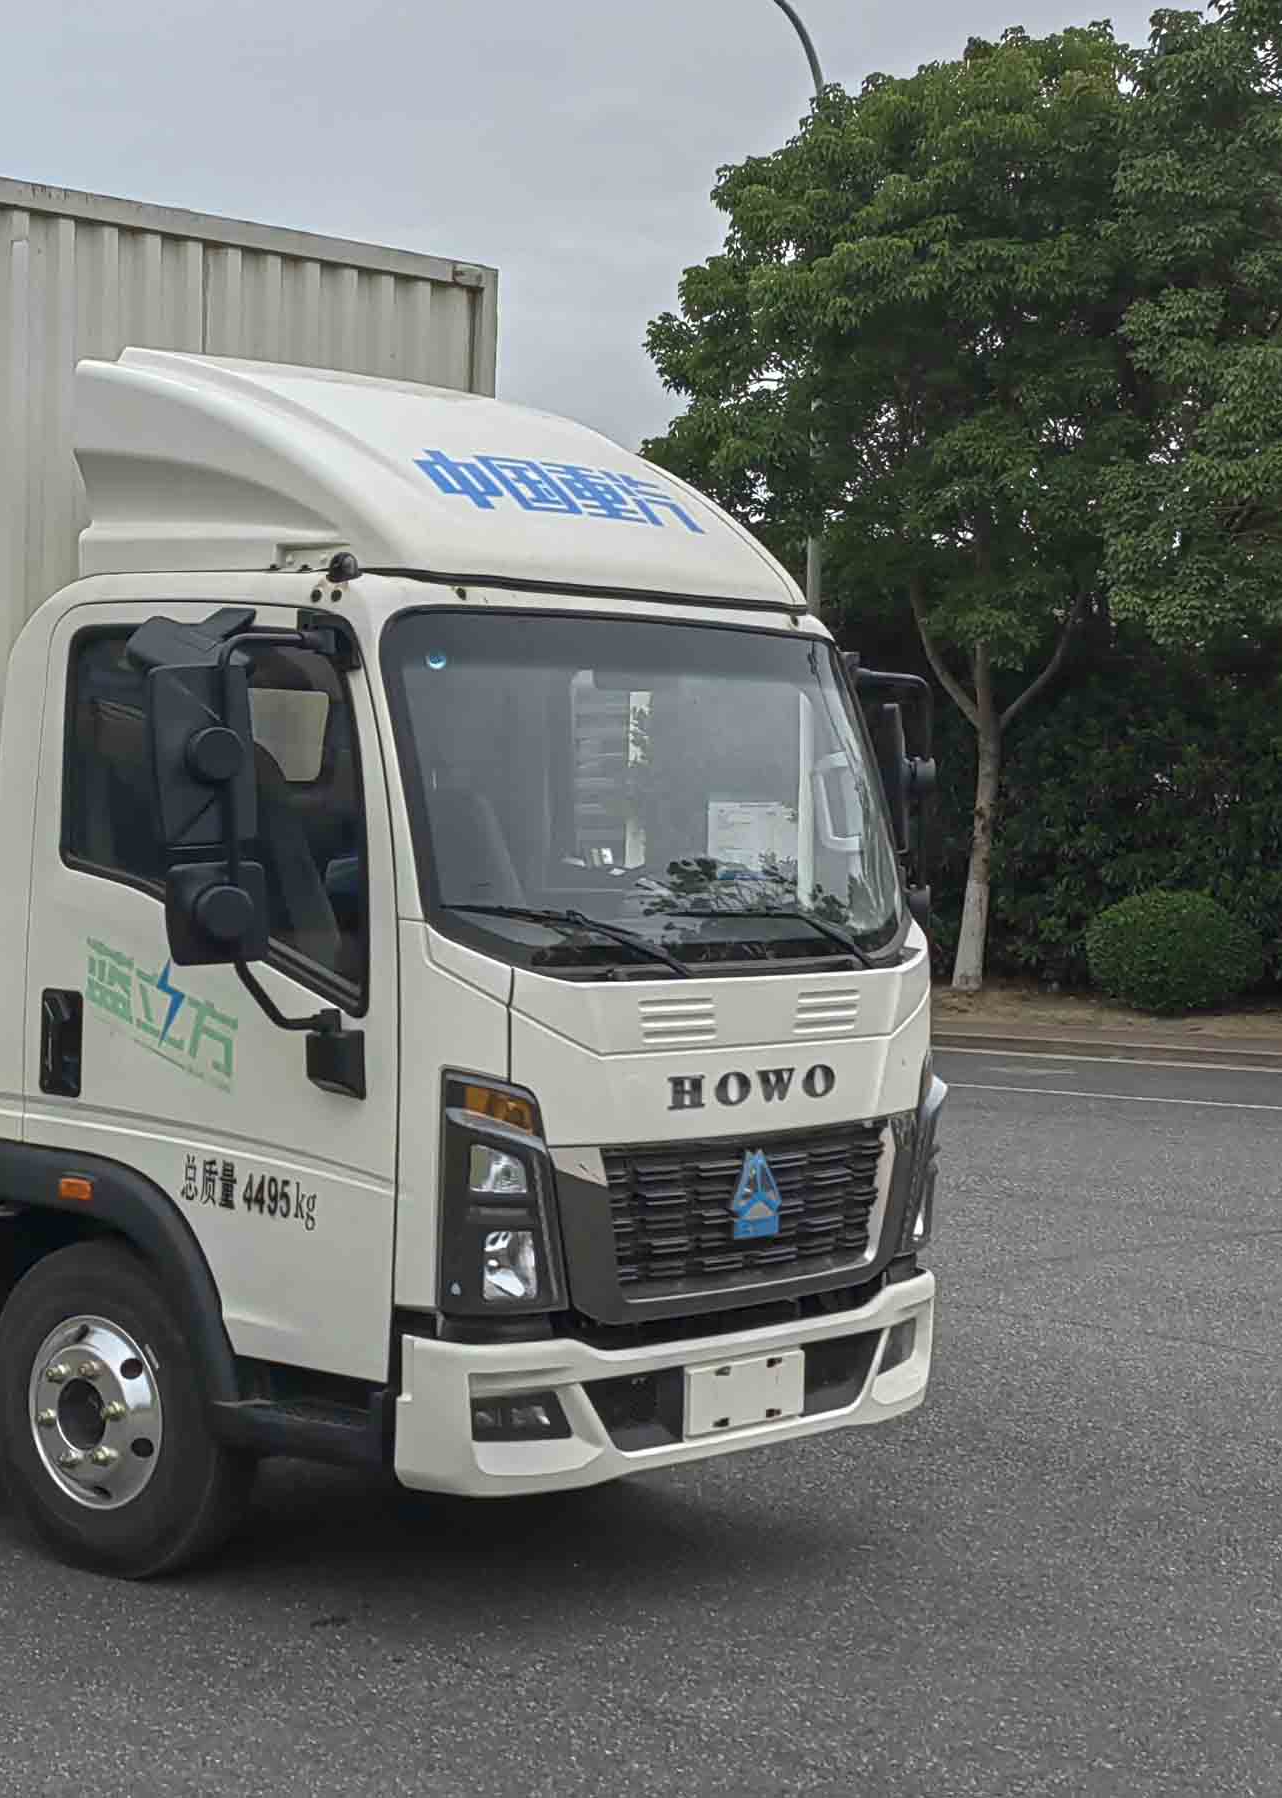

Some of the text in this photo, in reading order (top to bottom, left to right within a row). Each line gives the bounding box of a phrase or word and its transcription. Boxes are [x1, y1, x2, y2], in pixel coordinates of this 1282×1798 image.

[413, 449, 705, 535] 中国重汽
[667, 1063, 836, 1110] HOWO
[180, 1154, 237, 1209] 总质量
